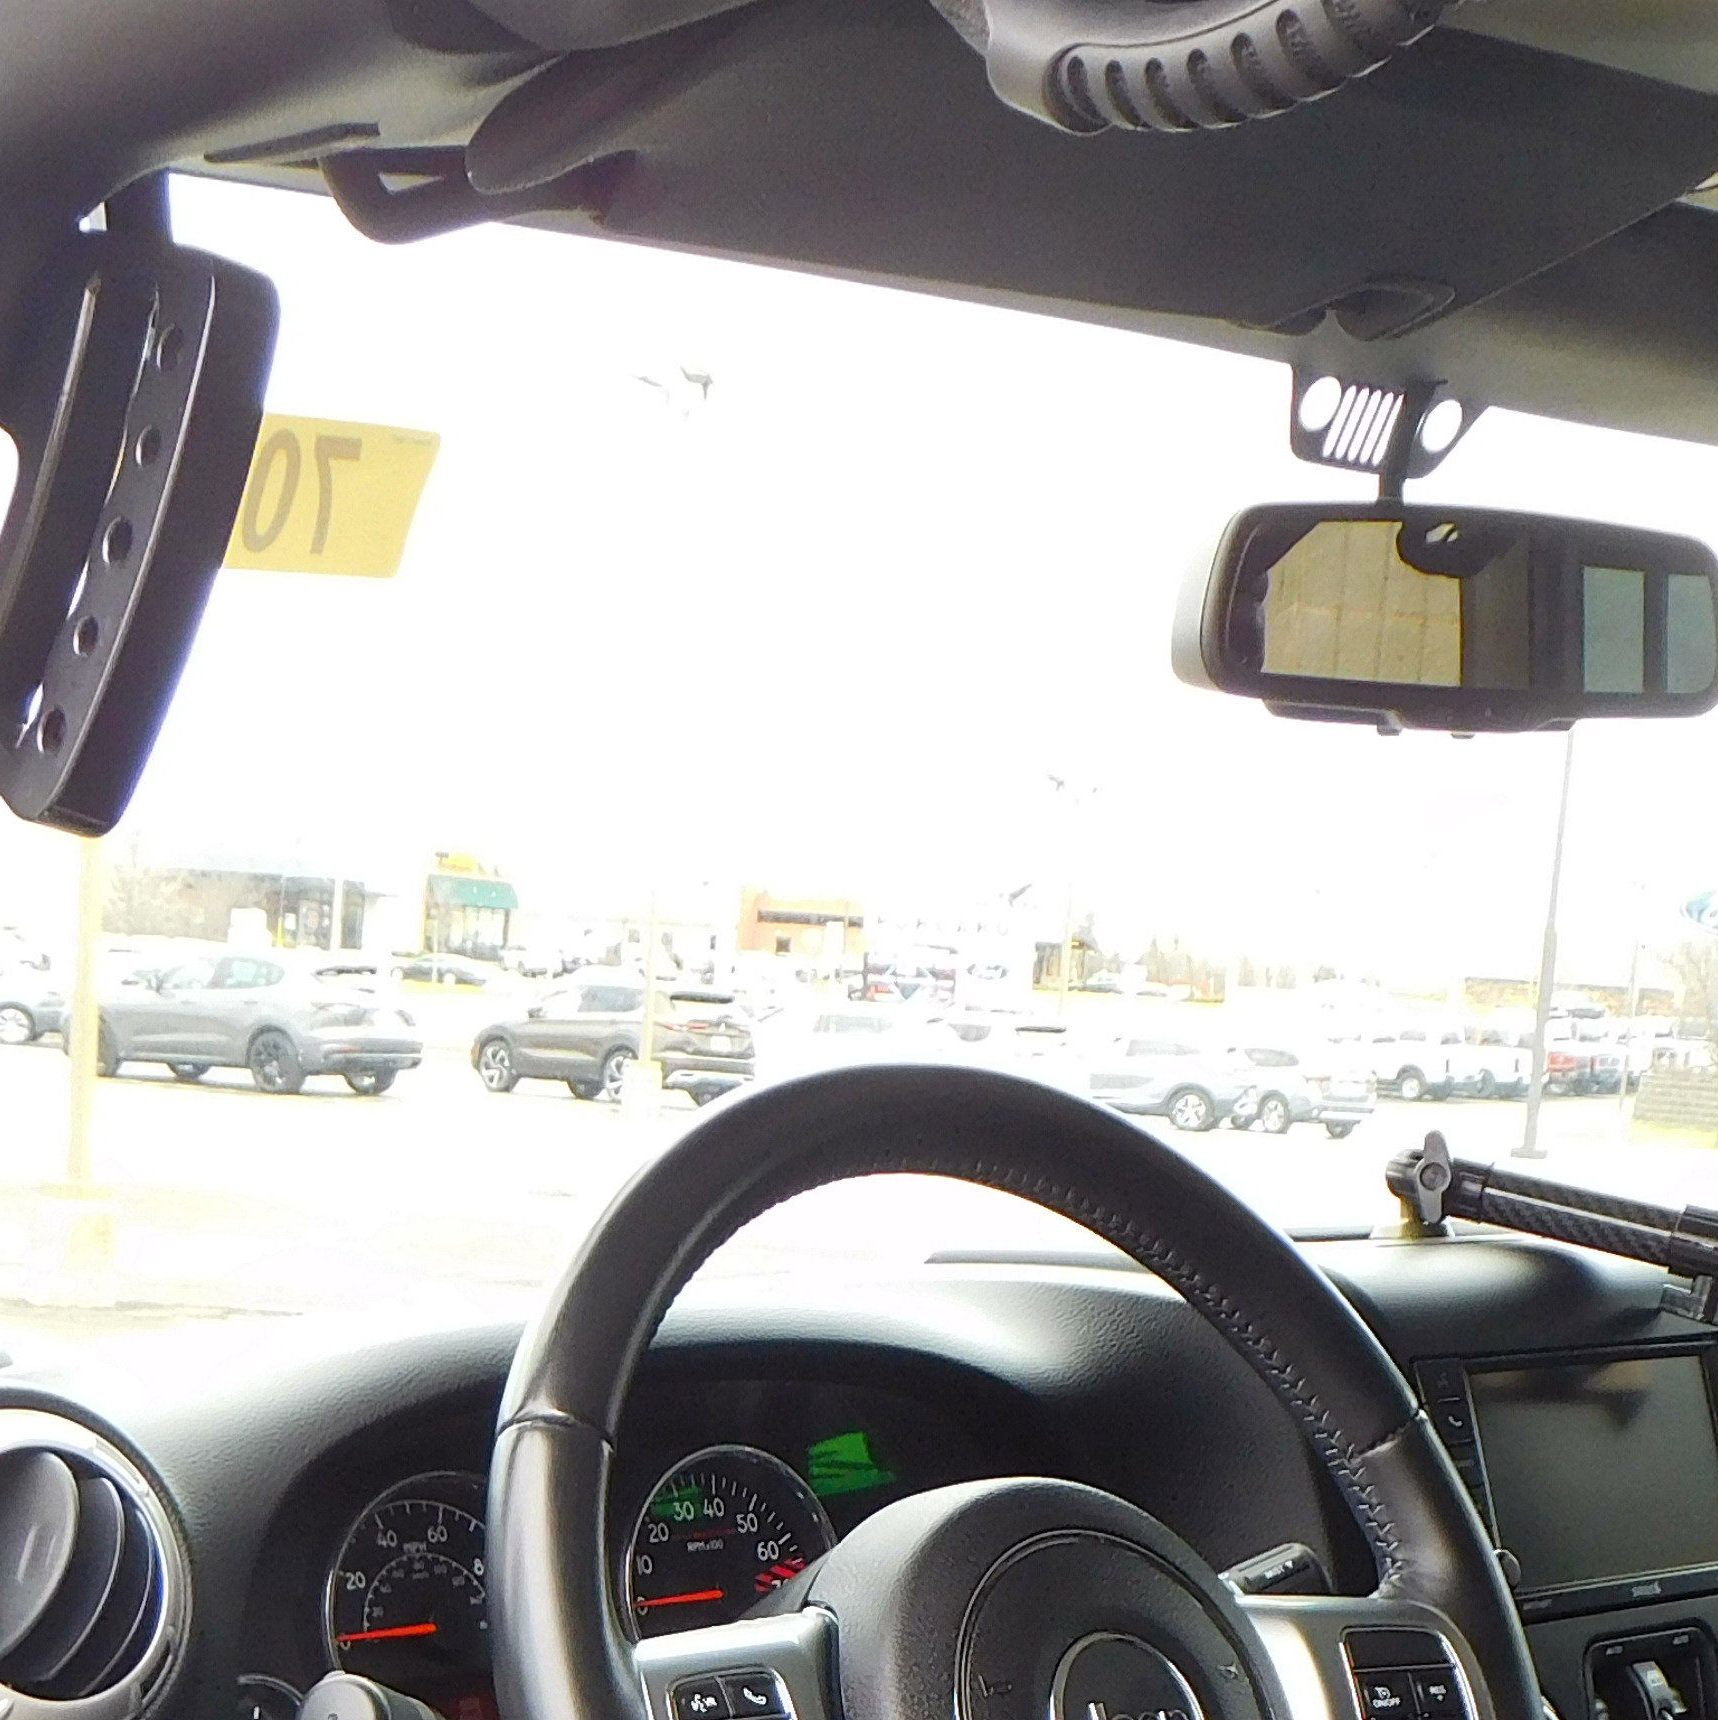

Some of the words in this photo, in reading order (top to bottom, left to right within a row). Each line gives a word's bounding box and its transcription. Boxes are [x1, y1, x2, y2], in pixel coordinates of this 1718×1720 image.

[672, 1501, 694, 1521] 30
[703, 1497, 724, 1518] 40
[647, 1522, 669, 1543] 20
[736, 1512, 758, 1533] 50
[376, 1528, 398, 1548] 40
[426, 1524, 448, 1543] 60
[757, 1541, 779, 1561] 60
[635, 1554, 653, 1575] 10
[345, 1570, 366, 1590] 20
